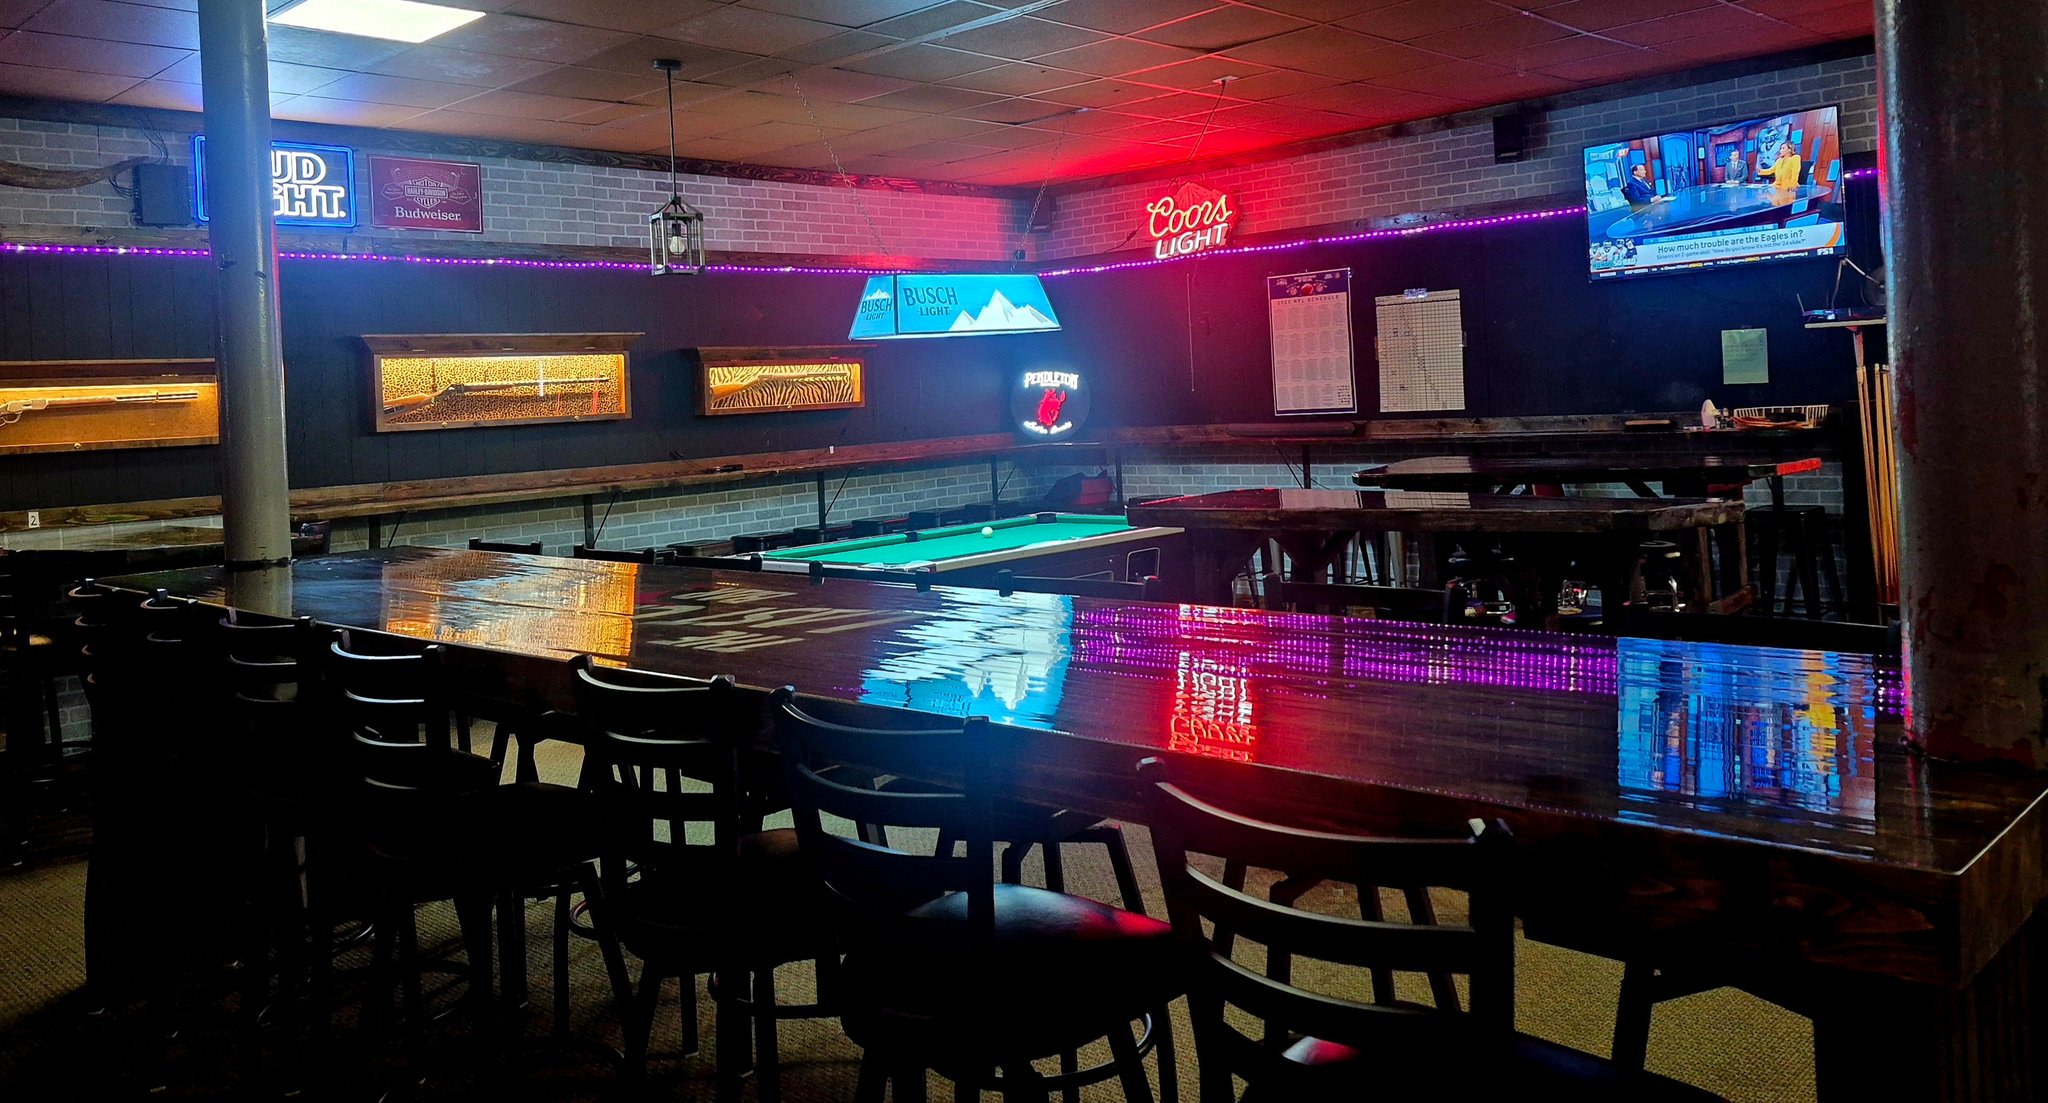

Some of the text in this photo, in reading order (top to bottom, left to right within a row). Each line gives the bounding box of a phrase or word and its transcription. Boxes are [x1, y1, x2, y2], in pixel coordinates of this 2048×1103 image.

[271, 150, 327, 184] UD
[1146, 194, 1233, 238] Coors
[1155, 223, 1229, 259] LIGHT
[1658, 245, 1675, 254] How
[1677, 242, 1699, 252] much
[1700, 237, 1729, 248] trouble
[1731, 237, 1744, 245] are
[1746, 234, 1759, 244] the
[1761, 231, 1789, 243] Eagles
[1790, 229, 1804, 239] in?
[860, 298, 893, 314] BUSCH
[903, 287, 959, 306] BUSCH
[865, 312, 884, 321] LIGHT
[919, 306, 951, 316] LIGHT
[1023, 371, 1080, 390] PENDLETON
[30, 515, 38, 526] 2
